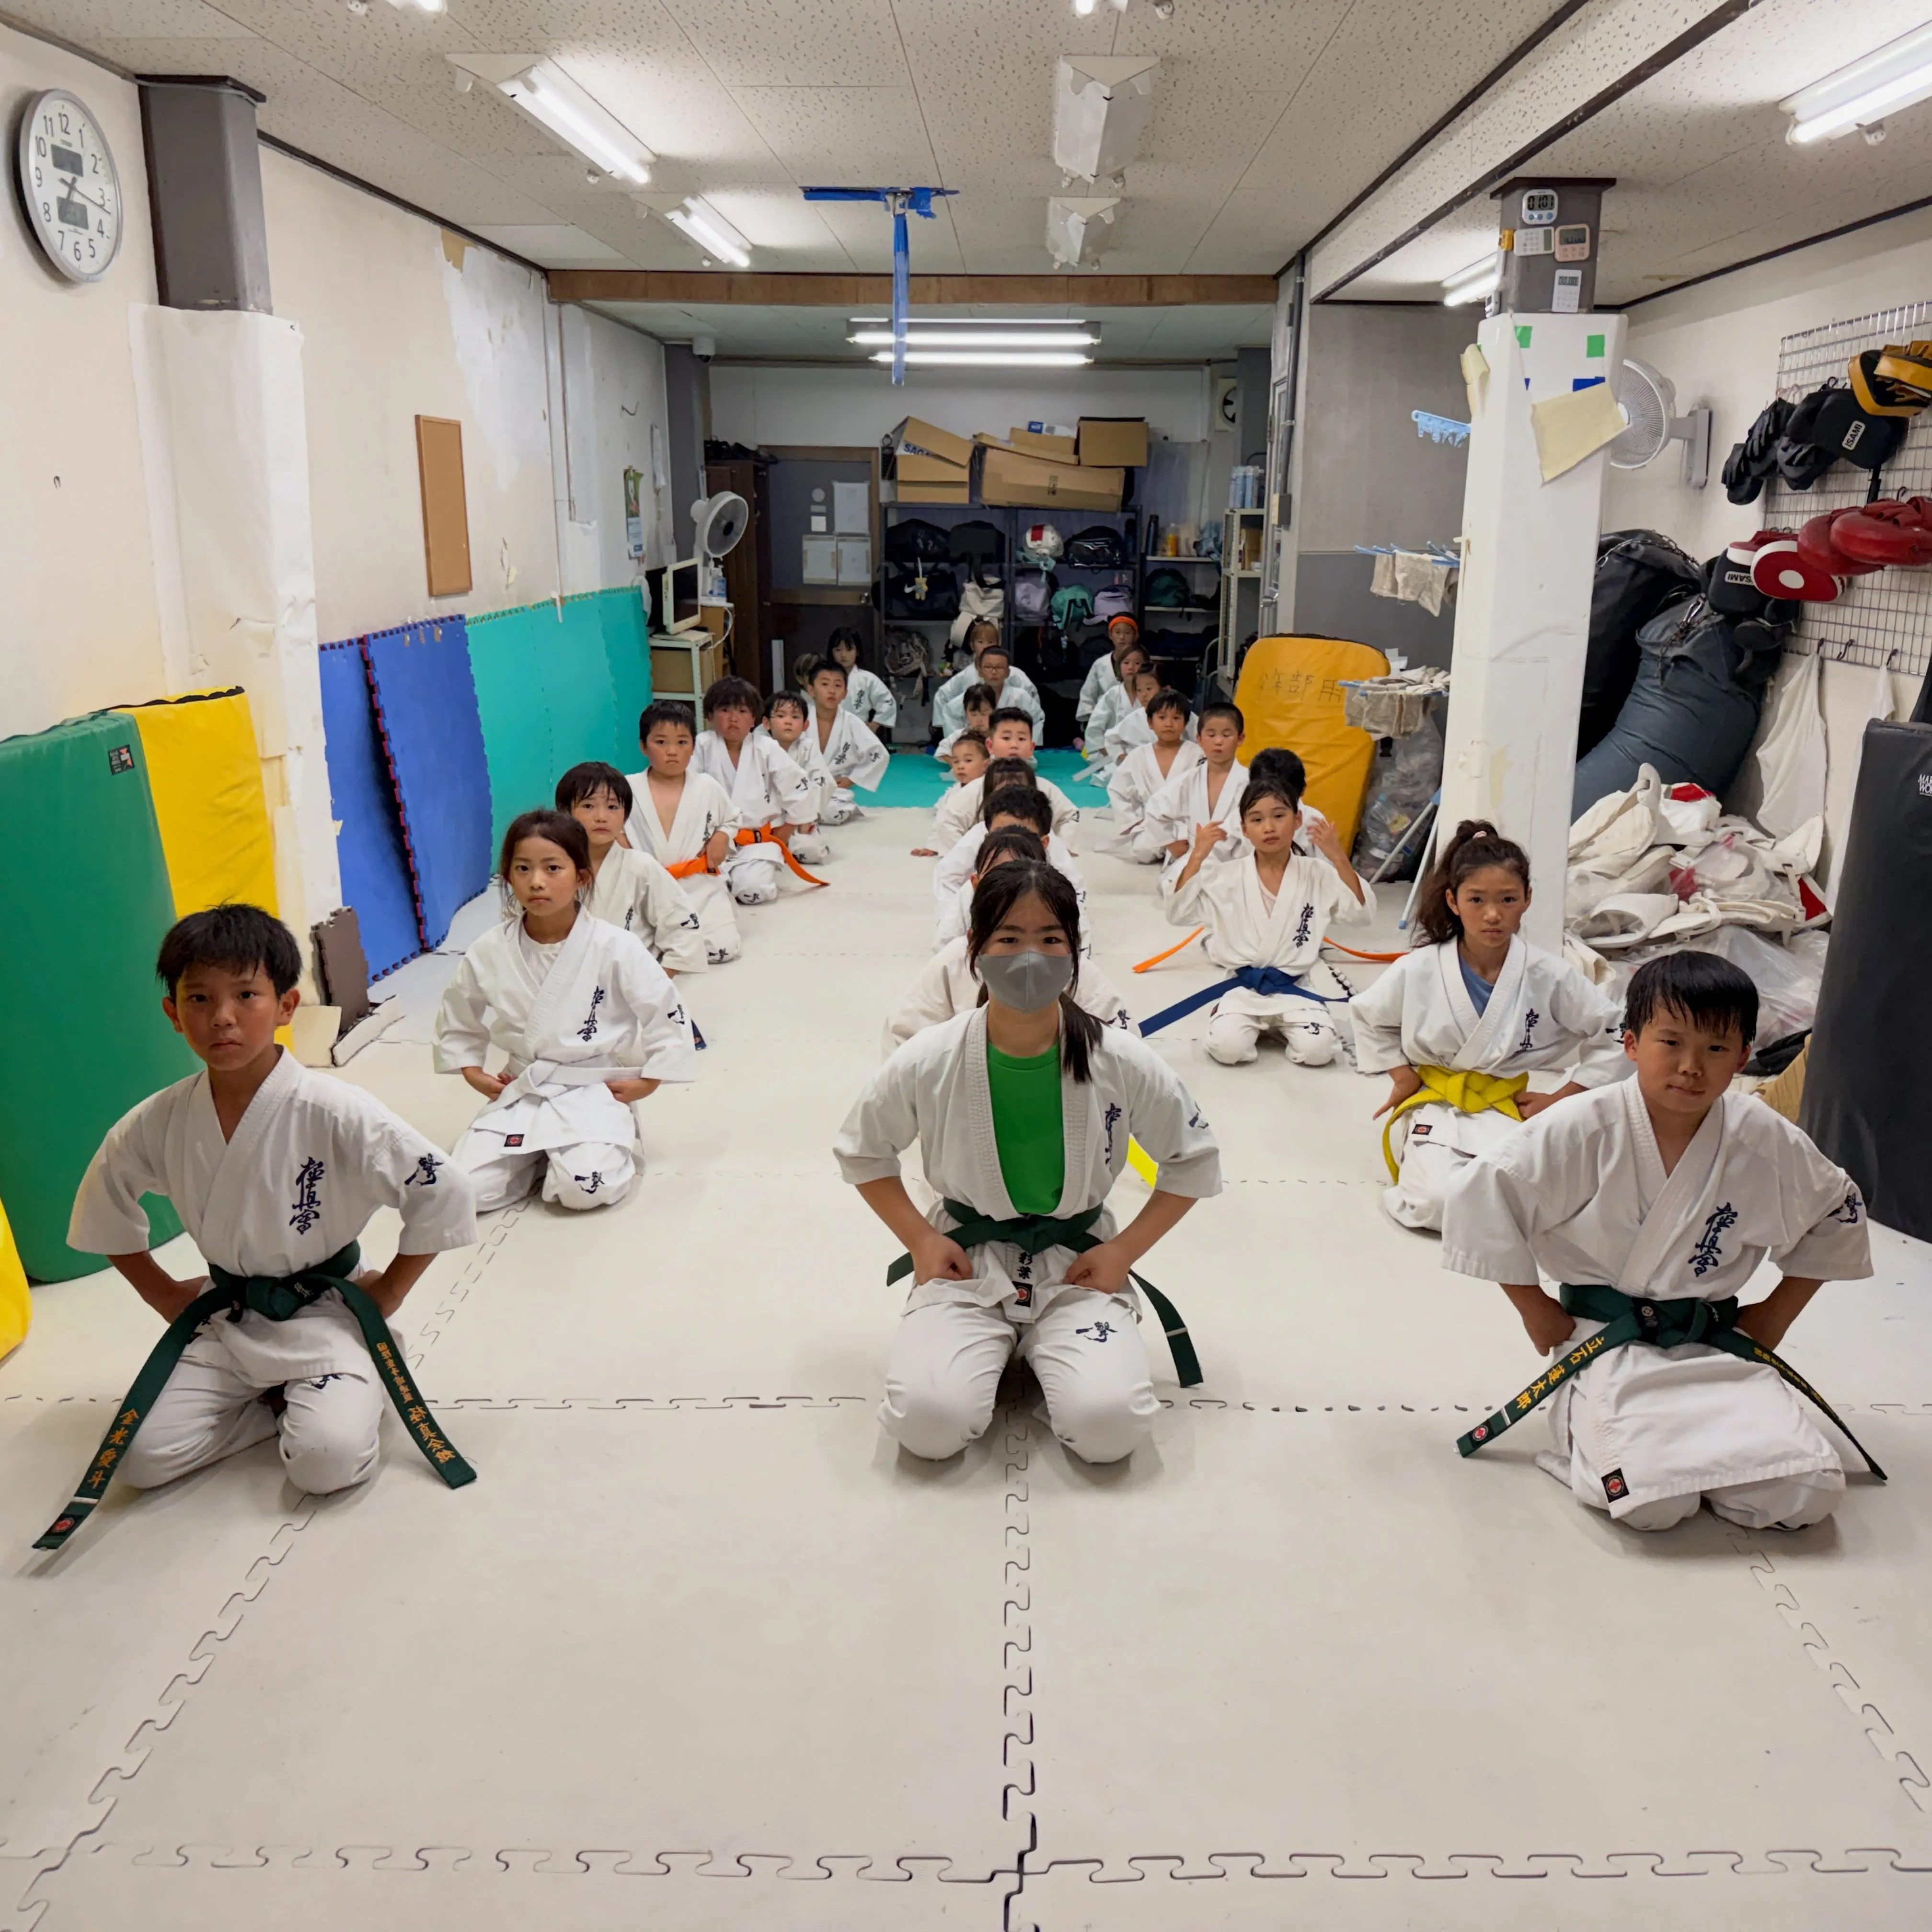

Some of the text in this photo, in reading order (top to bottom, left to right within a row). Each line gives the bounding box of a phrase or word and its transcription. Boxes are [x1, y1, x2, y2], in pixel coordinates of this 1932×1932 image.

[44, 115, 54, 138] 11
[58, 112, 70, 135] 12
[35, 136, 46, 157] 10
[79, 128, 84, 148] 1
[91, 153, 99, 174] 2
[35, 167, 42, 187] 9
[99, 187, 105, 207] 3
[43, 202, 51, 222] 8
[97, 218, 104, 238] 4
[58, 230, 64, 250] 7
[88, 238, 95, 258] 5
[74, 242, 81, 261] 6
[1845, 424, 1863, 448] ISAMI
[1727, 574, 1753, 584] SAMI
[1569, 1336, 1605, 1365] 立石
